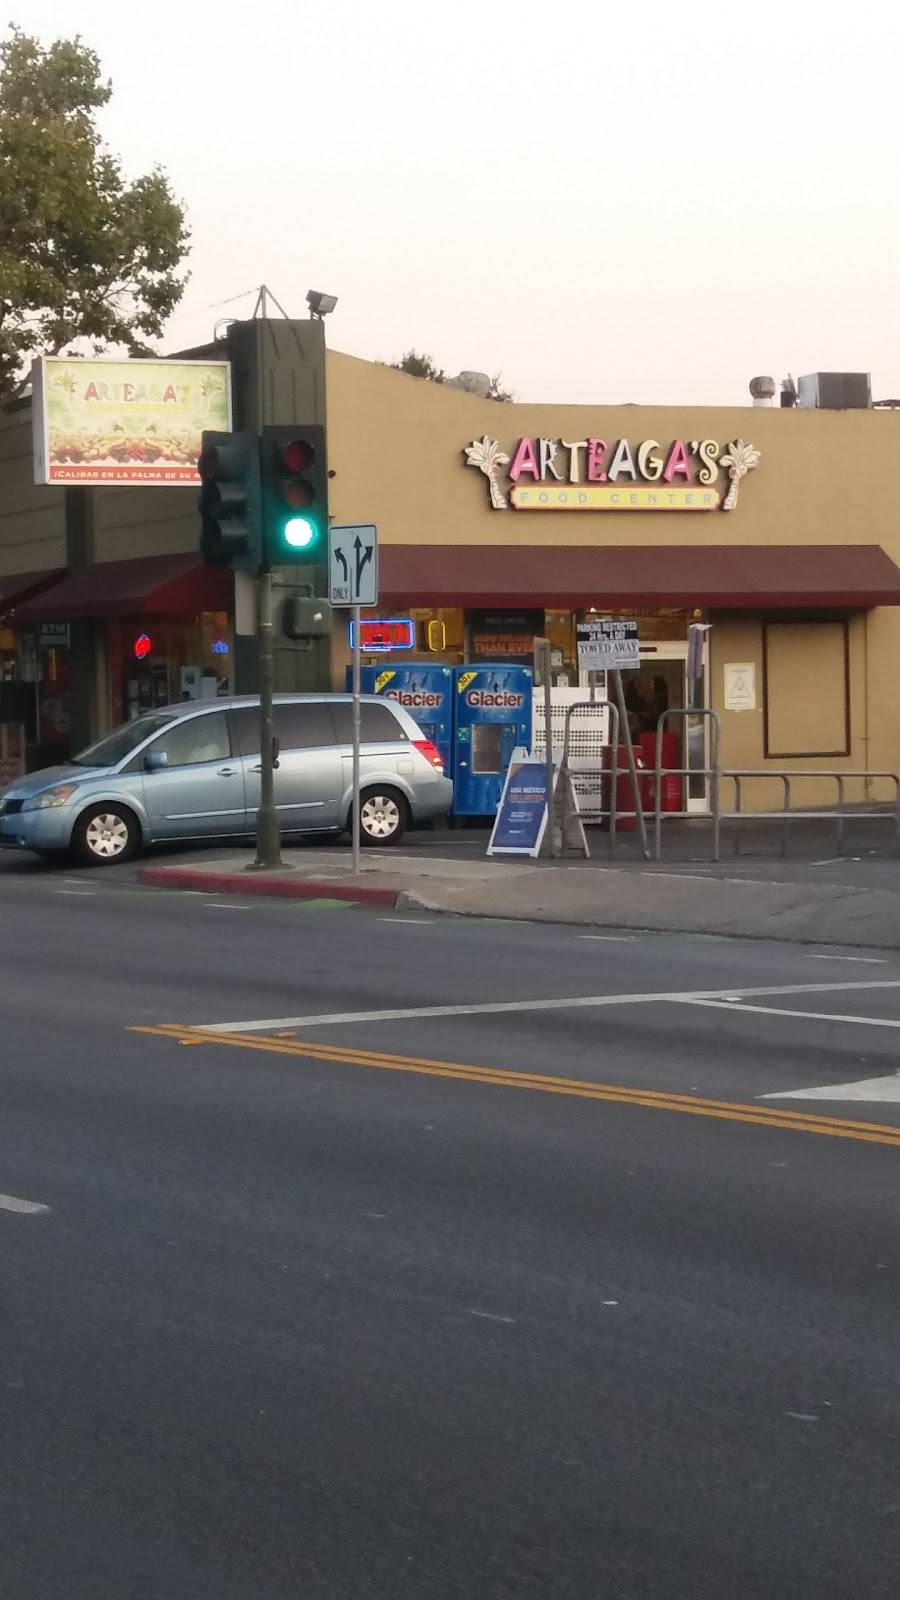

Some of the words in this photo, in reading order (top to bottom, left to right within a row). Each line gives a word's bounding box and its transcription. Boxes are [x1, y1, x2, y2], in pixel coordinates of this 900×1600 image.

[83, 382, 191, 403] ARTEAGA'S
[508, 436, 720, 485] ARTEAGA'S
[519, 491, 588, 504] FOOD
[610, 491, 714, 504] CENTER
[332, 587, 349, 600] ONLY
[41, 623, 65, 633] ATM
[602, 622, 637, 631] RESTRICTED
[580, 643, 611, 654] TOWED
[613, 642, 637, 652] AWAY
[467, 691, 523, 707] Glacier
